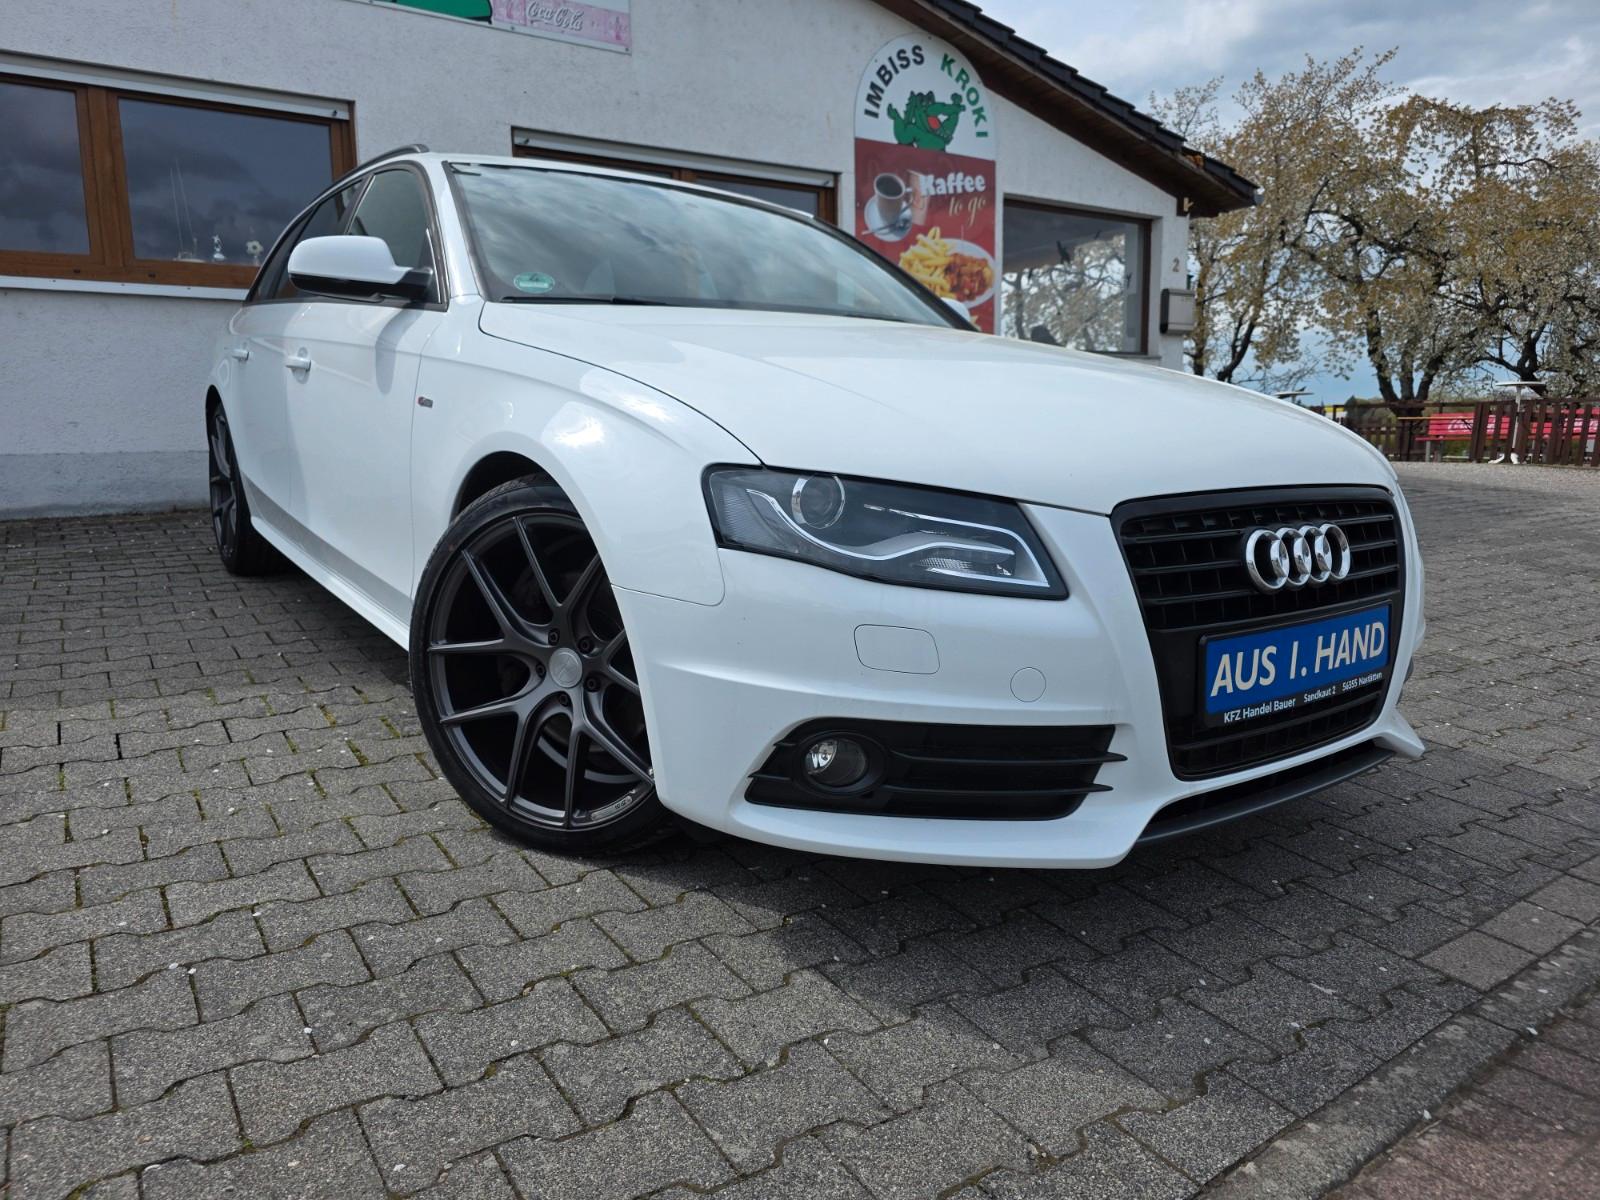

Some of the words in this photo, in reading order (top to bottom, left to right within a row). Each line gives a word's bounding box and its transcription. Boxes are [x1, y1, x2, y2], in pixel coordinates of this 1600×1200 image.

[864, 44, 925, 120] IMBISS
[940, 53, 988, 138] KROKI
[919, 171, 985, 197] Kaffee
[949, 196, 963, 217] to
[967, 197, 987, 228] go
[1172, 258, 1180, 272] 2
[1210, 645, 1277, 697] AUS
[1289, 641, 1307, 680] I.
[1314, 621, 1386, 674] HAND
[1224, 710, 1241, 724] KFZ
[1242, 704, 1273, 719] Handel
[1273, 698, 1296, 711] Bauer
[1303, 689, 1332, 703] Sandkaut
[1331, 686, 1336, 695] 2
[1342, 678, 1358, 692] 56355
